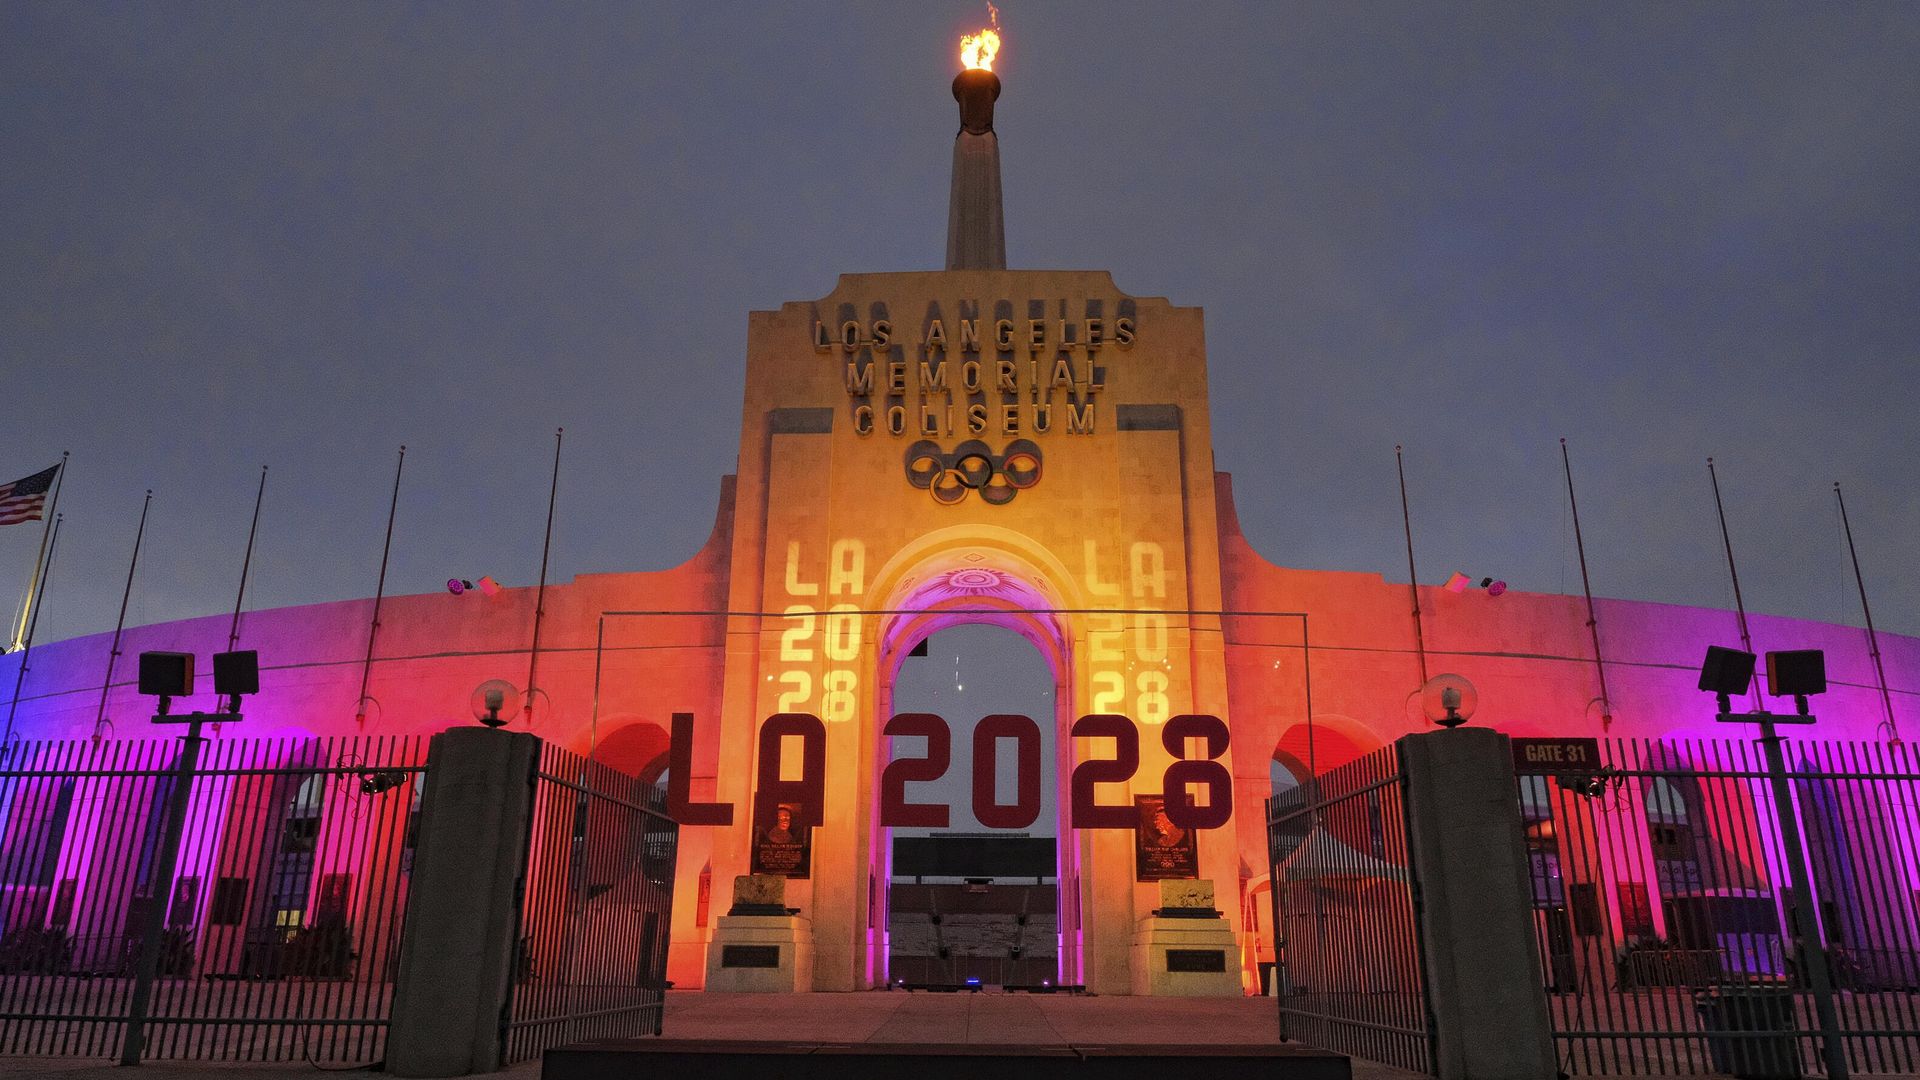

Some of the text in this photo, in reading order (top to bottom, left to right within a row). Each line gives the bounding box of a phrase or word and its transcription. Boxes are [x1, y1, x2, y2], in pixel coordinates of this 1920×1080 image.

[814, 317, 1136, 353] LOS ANGELES
[846, 359, 1105, 395] MEMORIAL
[853, 402, 1096, 437] COLISEUM
[785, 538, 866, 596] LA
[1083, 539, 1167, 598] LA
[666, 712, 1233, 830] LA 2028
[1525, 744, 1587, 762] GATE 31
